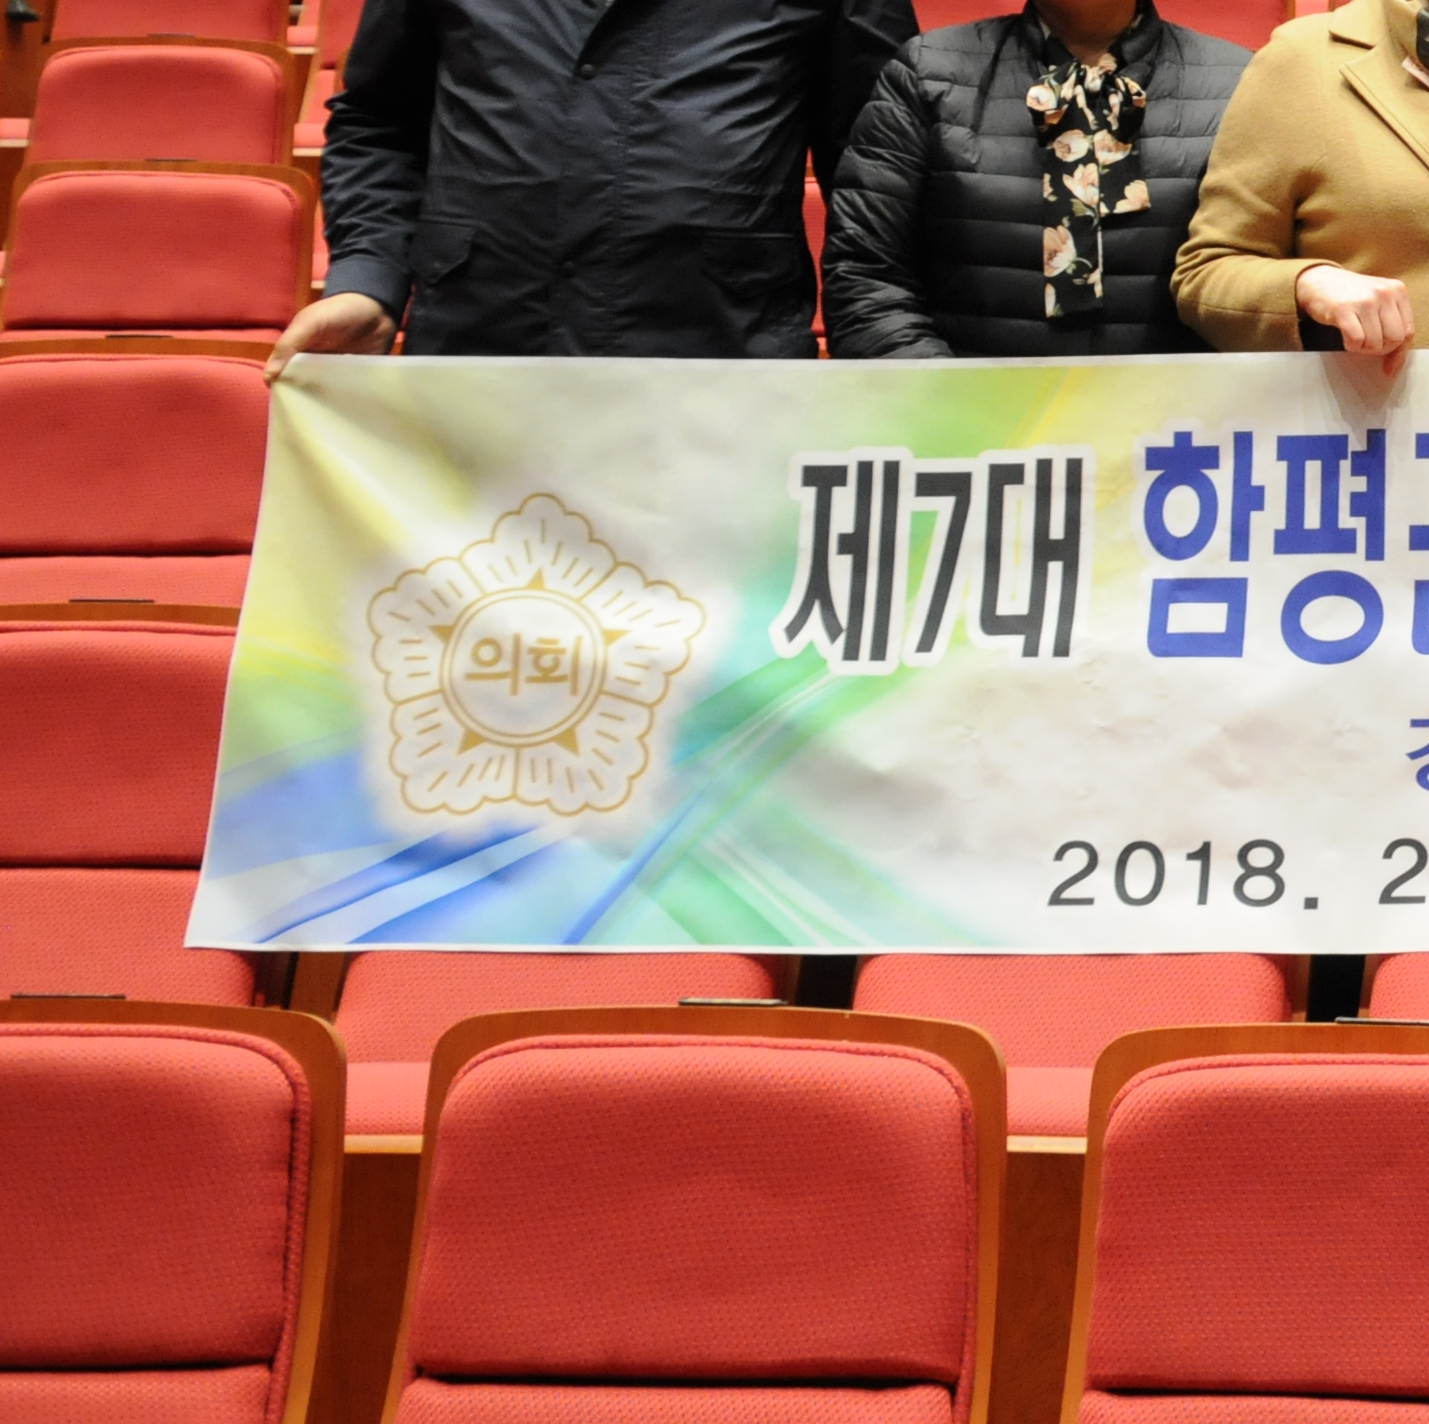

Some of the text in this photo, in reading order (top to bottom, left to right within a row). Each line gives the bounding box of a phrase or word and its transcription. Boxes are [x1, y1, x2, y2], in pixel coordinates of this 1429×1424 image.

[785, 457, 1083, 662] 제7대
[464, 632, 583, 696] 의회
[1046, 839, 1321, 910] 2018.
